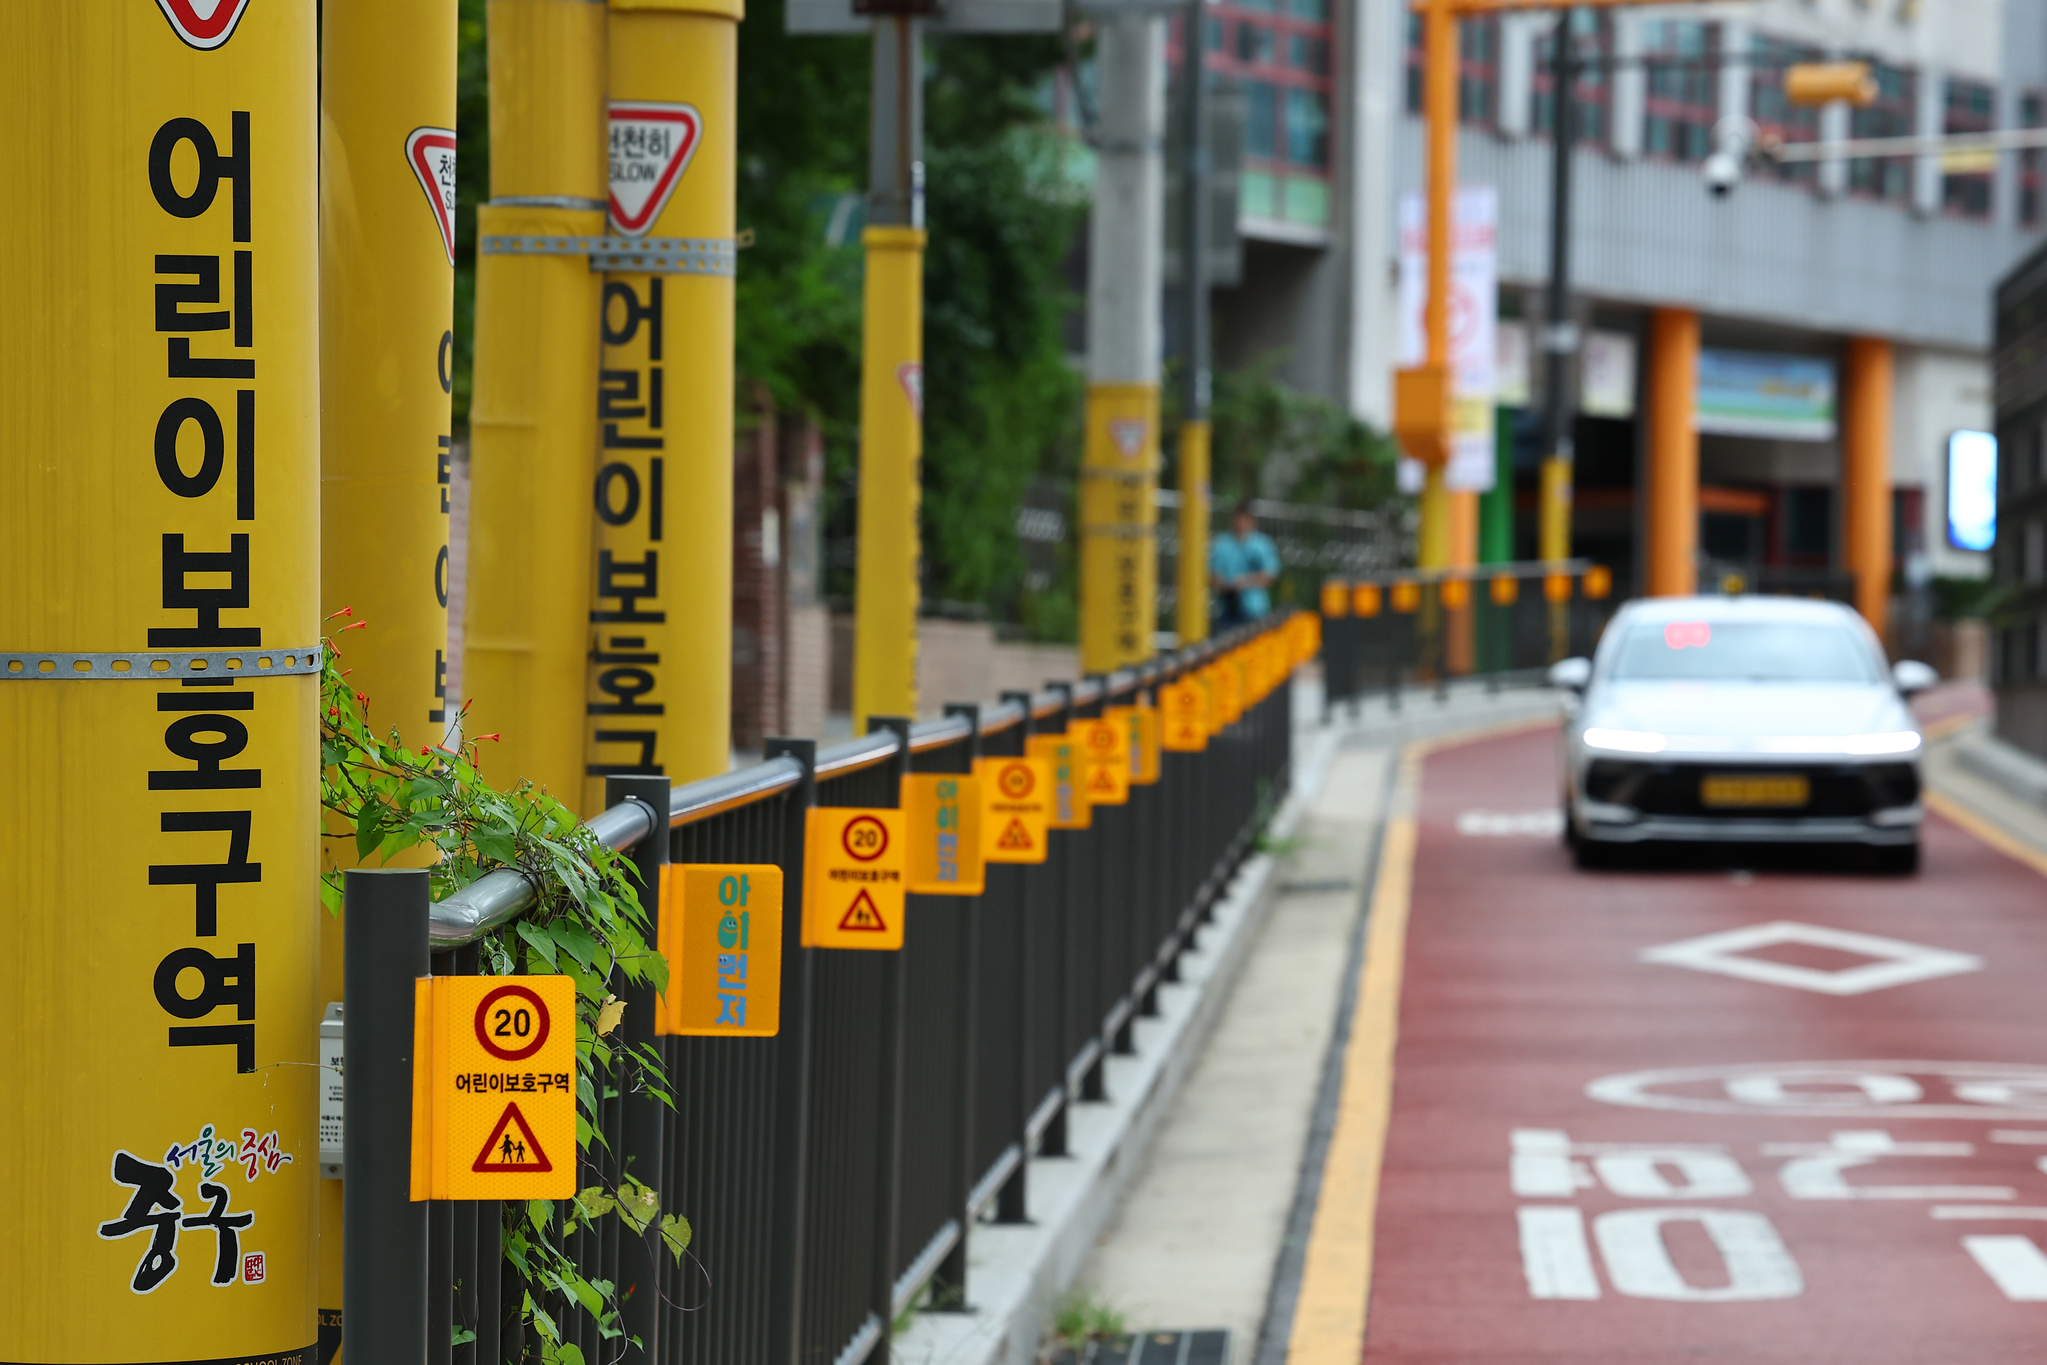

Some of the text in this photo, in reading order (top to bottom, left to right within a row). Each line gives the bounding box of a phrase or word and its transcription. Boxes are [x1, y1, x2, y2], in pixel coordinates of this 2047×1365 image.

[148, 111, 261, 1074] 어린이보호구역
[853, 829, 878, 848] 20
[494, 1008, 531, 1038] 20
[455, 1073, 570, 1094] 어린이보호구역
[167, 1127, 292, 1179] 서울의 중심
[100, 1153, 253, 1291] 중구
